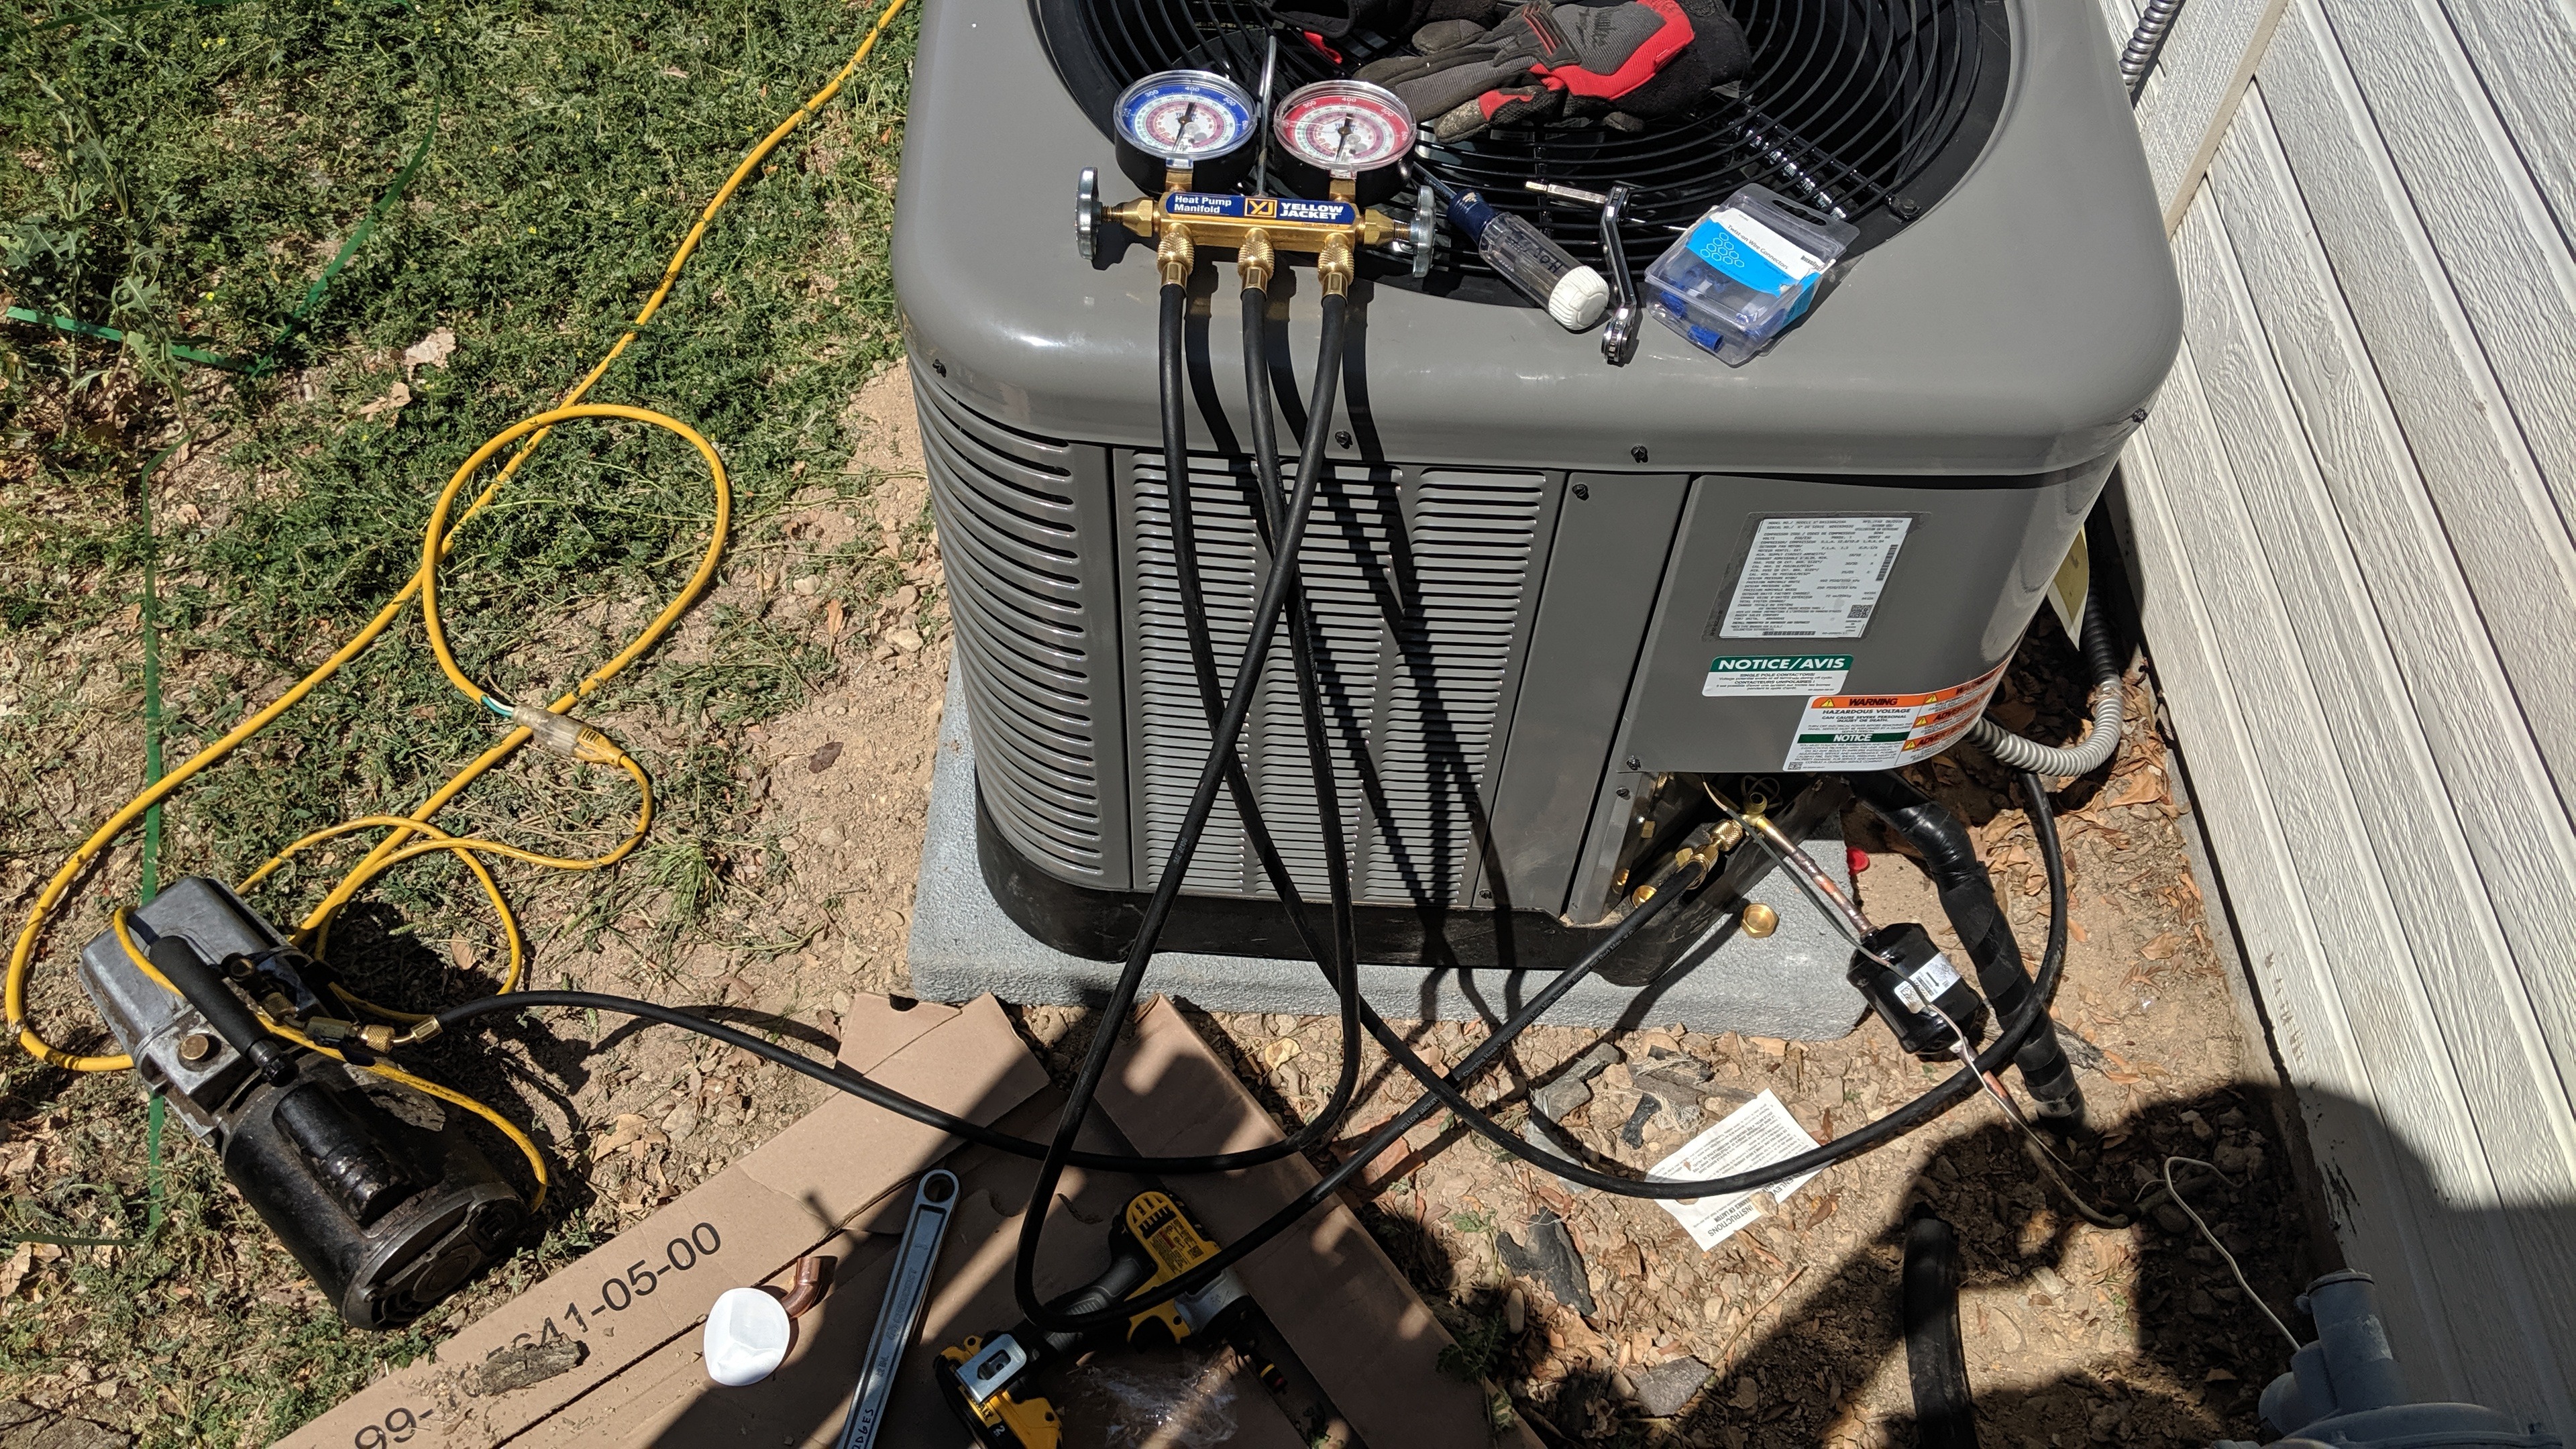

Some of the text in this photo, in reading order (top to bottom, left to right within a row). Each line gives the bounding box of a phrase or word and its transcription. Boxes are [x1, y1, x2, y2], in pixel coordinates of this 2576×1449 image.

[1175, 195, 1232, 207] Heat Pump
[1174, 204, 1220, 214] Manifold
[1281, 202, 1344, 213] YELLOW
[1280, 209, 1340, 220] JACKET
[1727, 224, 1789, 270] Twist-on Wire Connectors
[1718, 657, 1845, 670] NOTICE/AVIS
[1848, 698, 1898, 706] WARNING
[1833, 733, 1873, 742] NOTICE
[1399, 1112, 1420, 1131] YELLOW
[1419, 1097, 1438, 1115] JACKET
[1462, 1058, 1486, 1077] Charging
[1484, 1046, 1498, 1061] Hose
[1772, 1177, 1794, 1195] ENLEV
[1707, 1204, 1754, 1237] INSTRUCTIONS
[1713, 1210, 1730, 1223] LAITON
